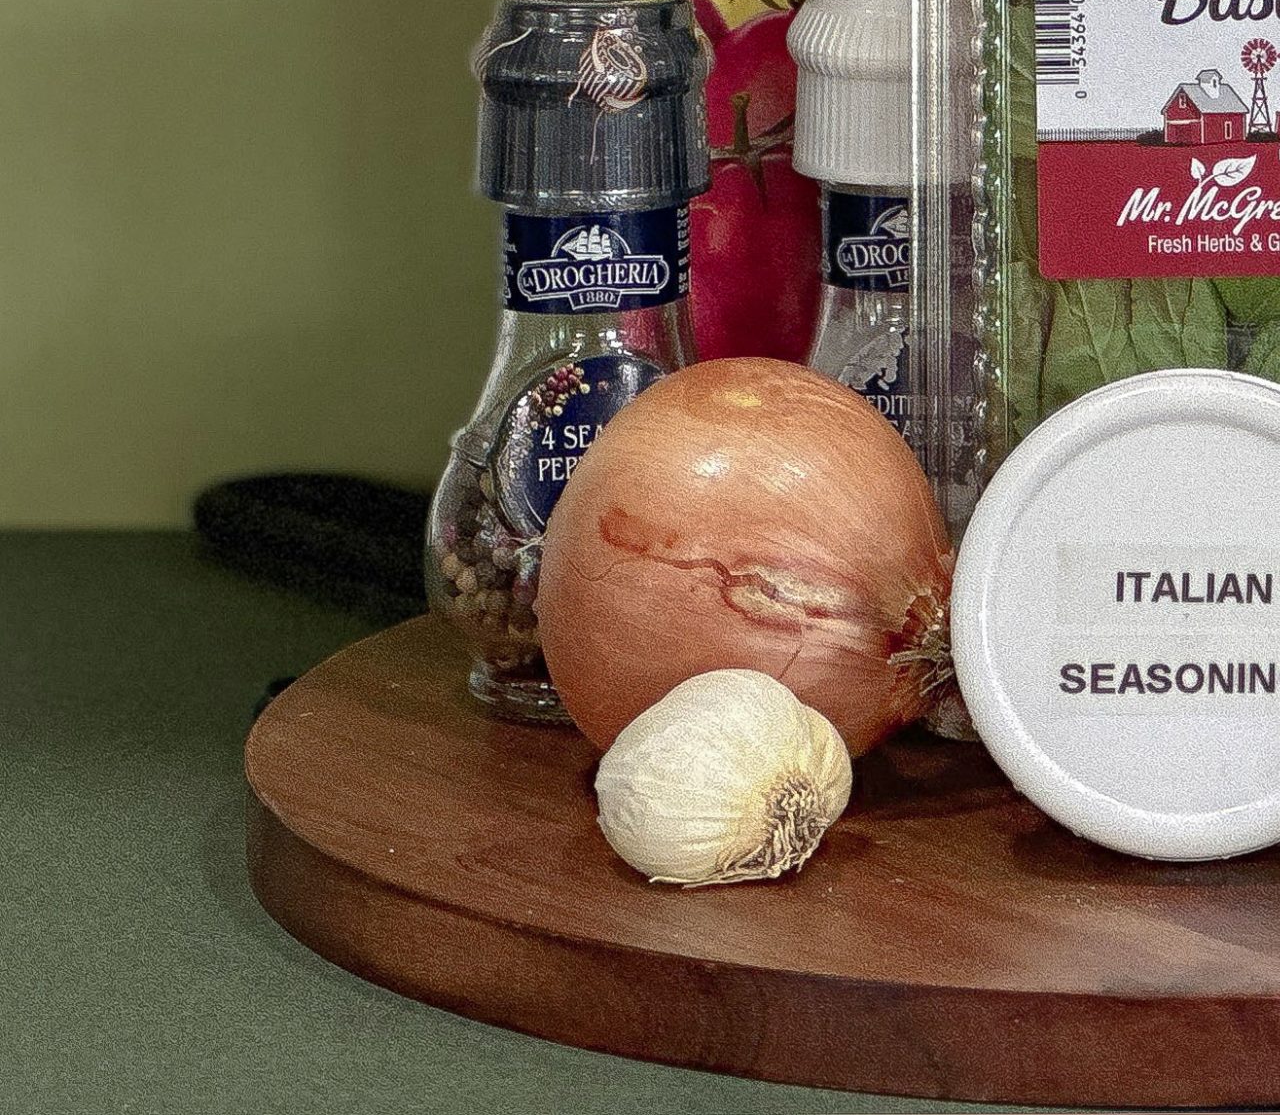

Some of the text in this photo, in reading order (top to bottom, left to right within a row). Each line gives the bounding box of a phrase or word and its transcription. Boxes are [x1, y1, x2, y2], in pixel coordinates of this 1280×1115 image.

[1072, 12, 1086, 68] 34364
[1076, 90, 1087, 100] 0
[1116, 187, 1173, 227] Mr.
[1148, 235, 1192, 253] Fresh
[1197, 234, 1244, 252] Herbs
[1250, 234, 1263, 252] &
[532, 262, 659, 293] DROGHERIA
[578, 291, 614, 304] 1880
[541, 425, 556, 451] 4
[1116, 571, 1274, 605] ITALIAN
